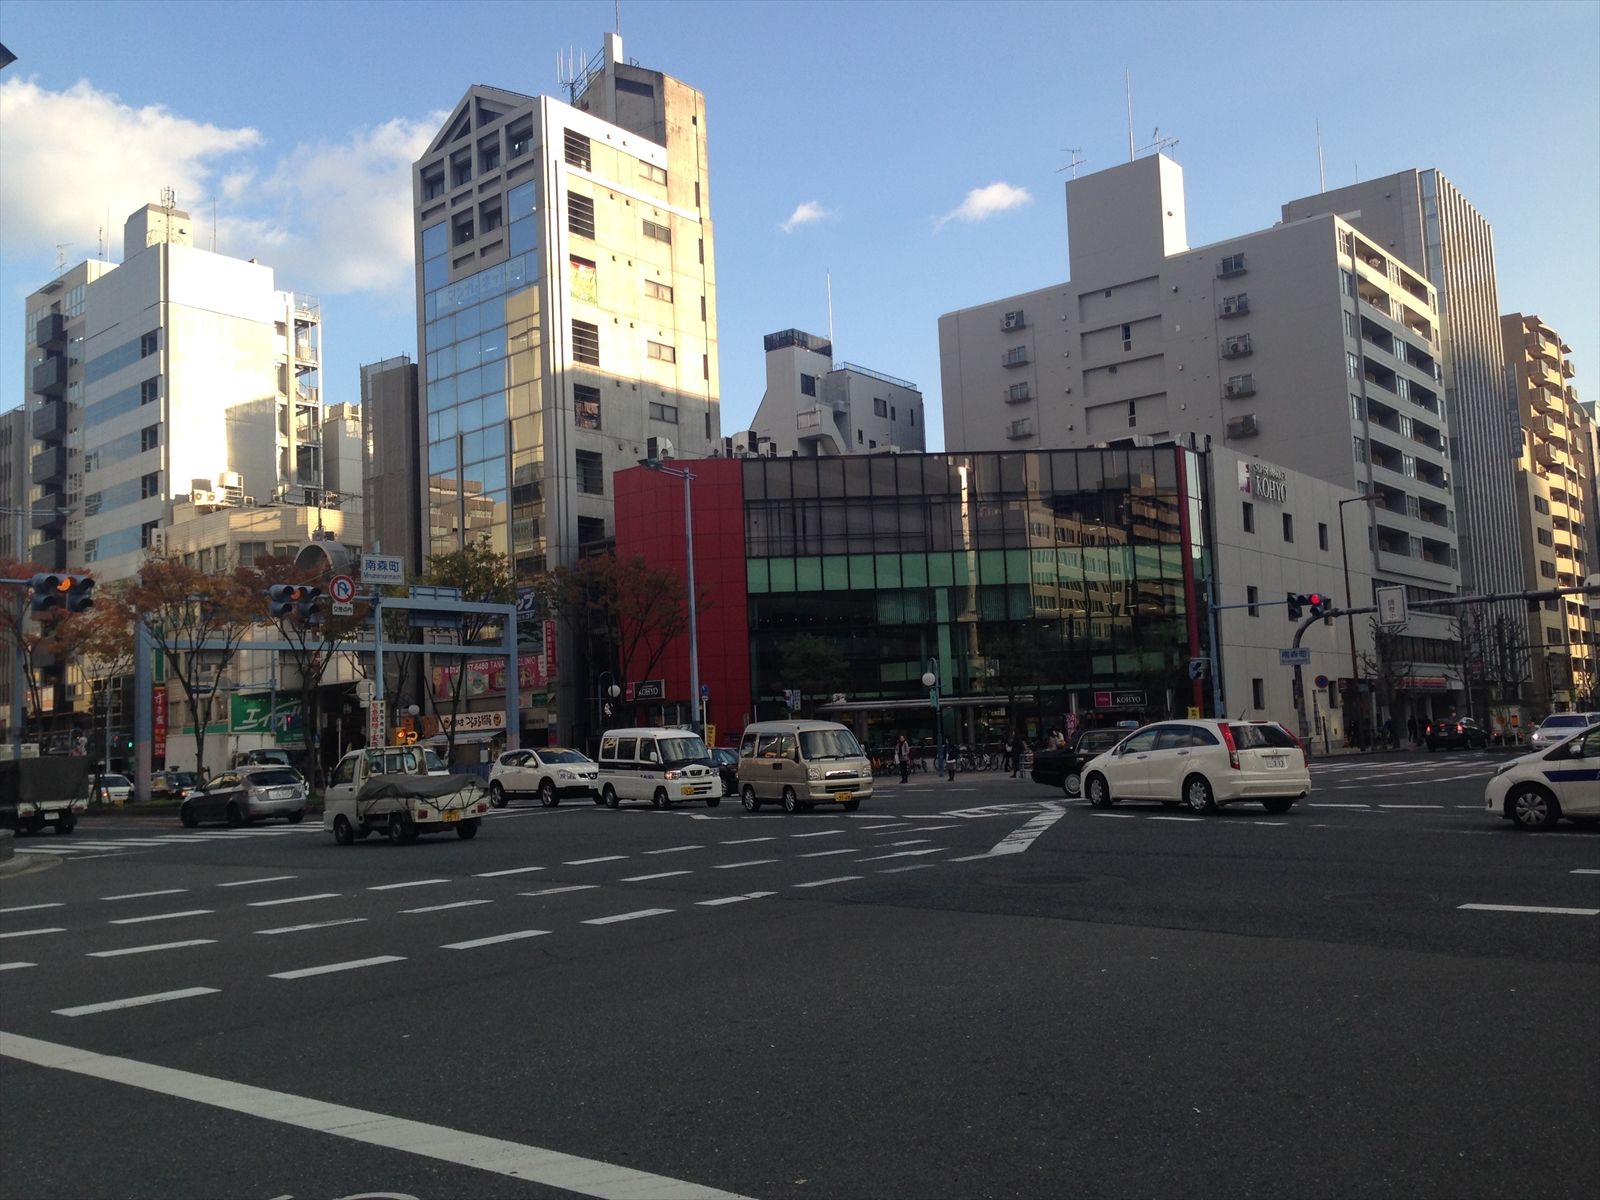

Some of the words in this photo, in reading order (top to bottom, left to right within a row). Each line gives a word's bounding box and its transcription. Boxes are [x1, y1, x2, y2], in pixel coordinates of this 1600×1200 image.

[1255, 475, 1287, 503] KOHYO
[365, 559, 400, 573] 南森町
[1116, 695, 1141, 704] KOHYO
